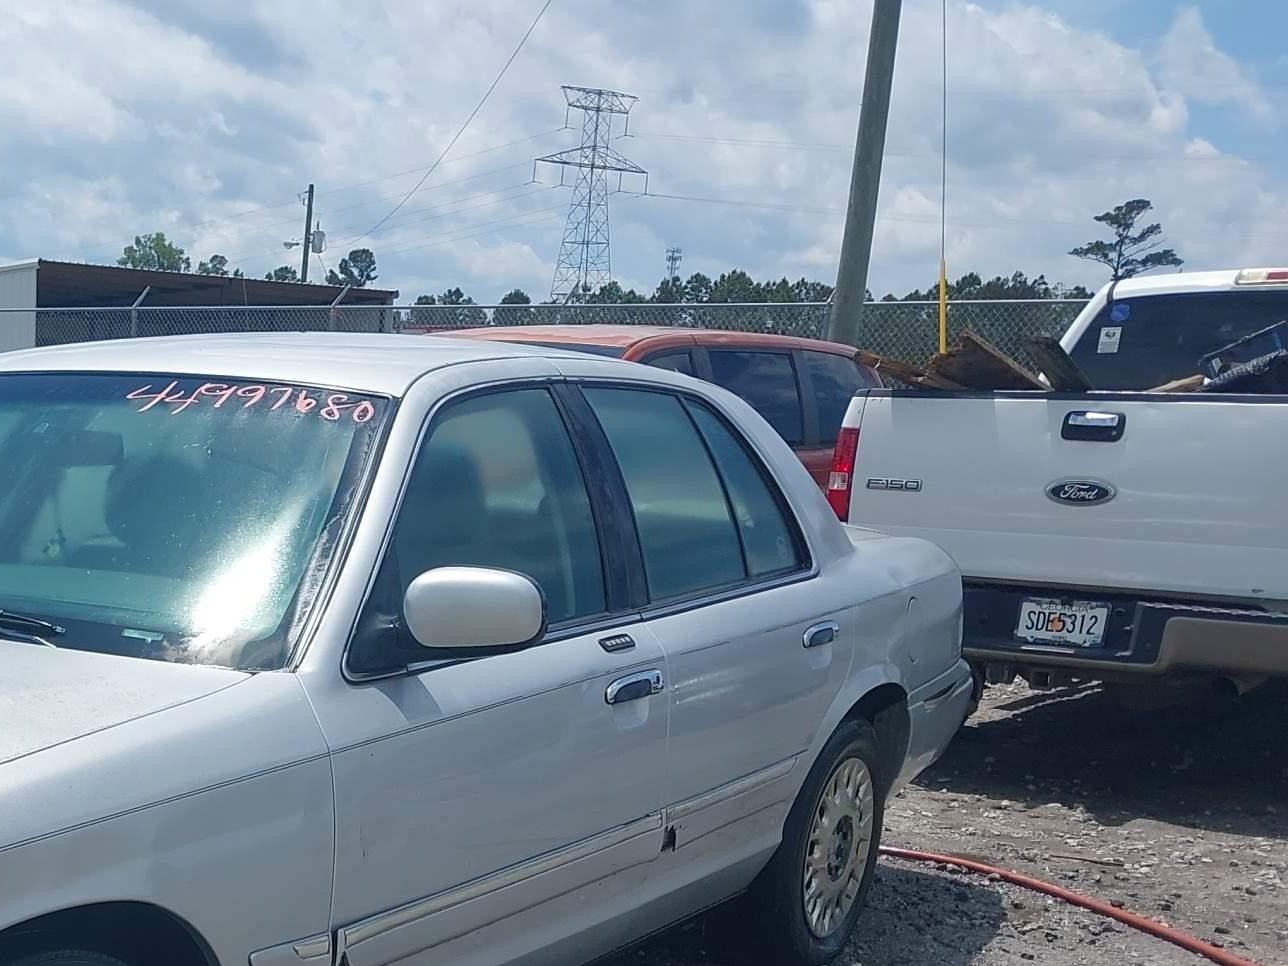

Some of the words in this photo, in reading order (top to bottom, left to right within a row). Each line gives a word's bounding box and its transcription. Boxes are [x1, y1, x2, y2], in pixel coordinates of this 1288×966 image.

[125, 380, 375, 423] 44997680
[1059, 483, 1098, 500] Ford
[1025, 610, 1099, 635] SDE5312
